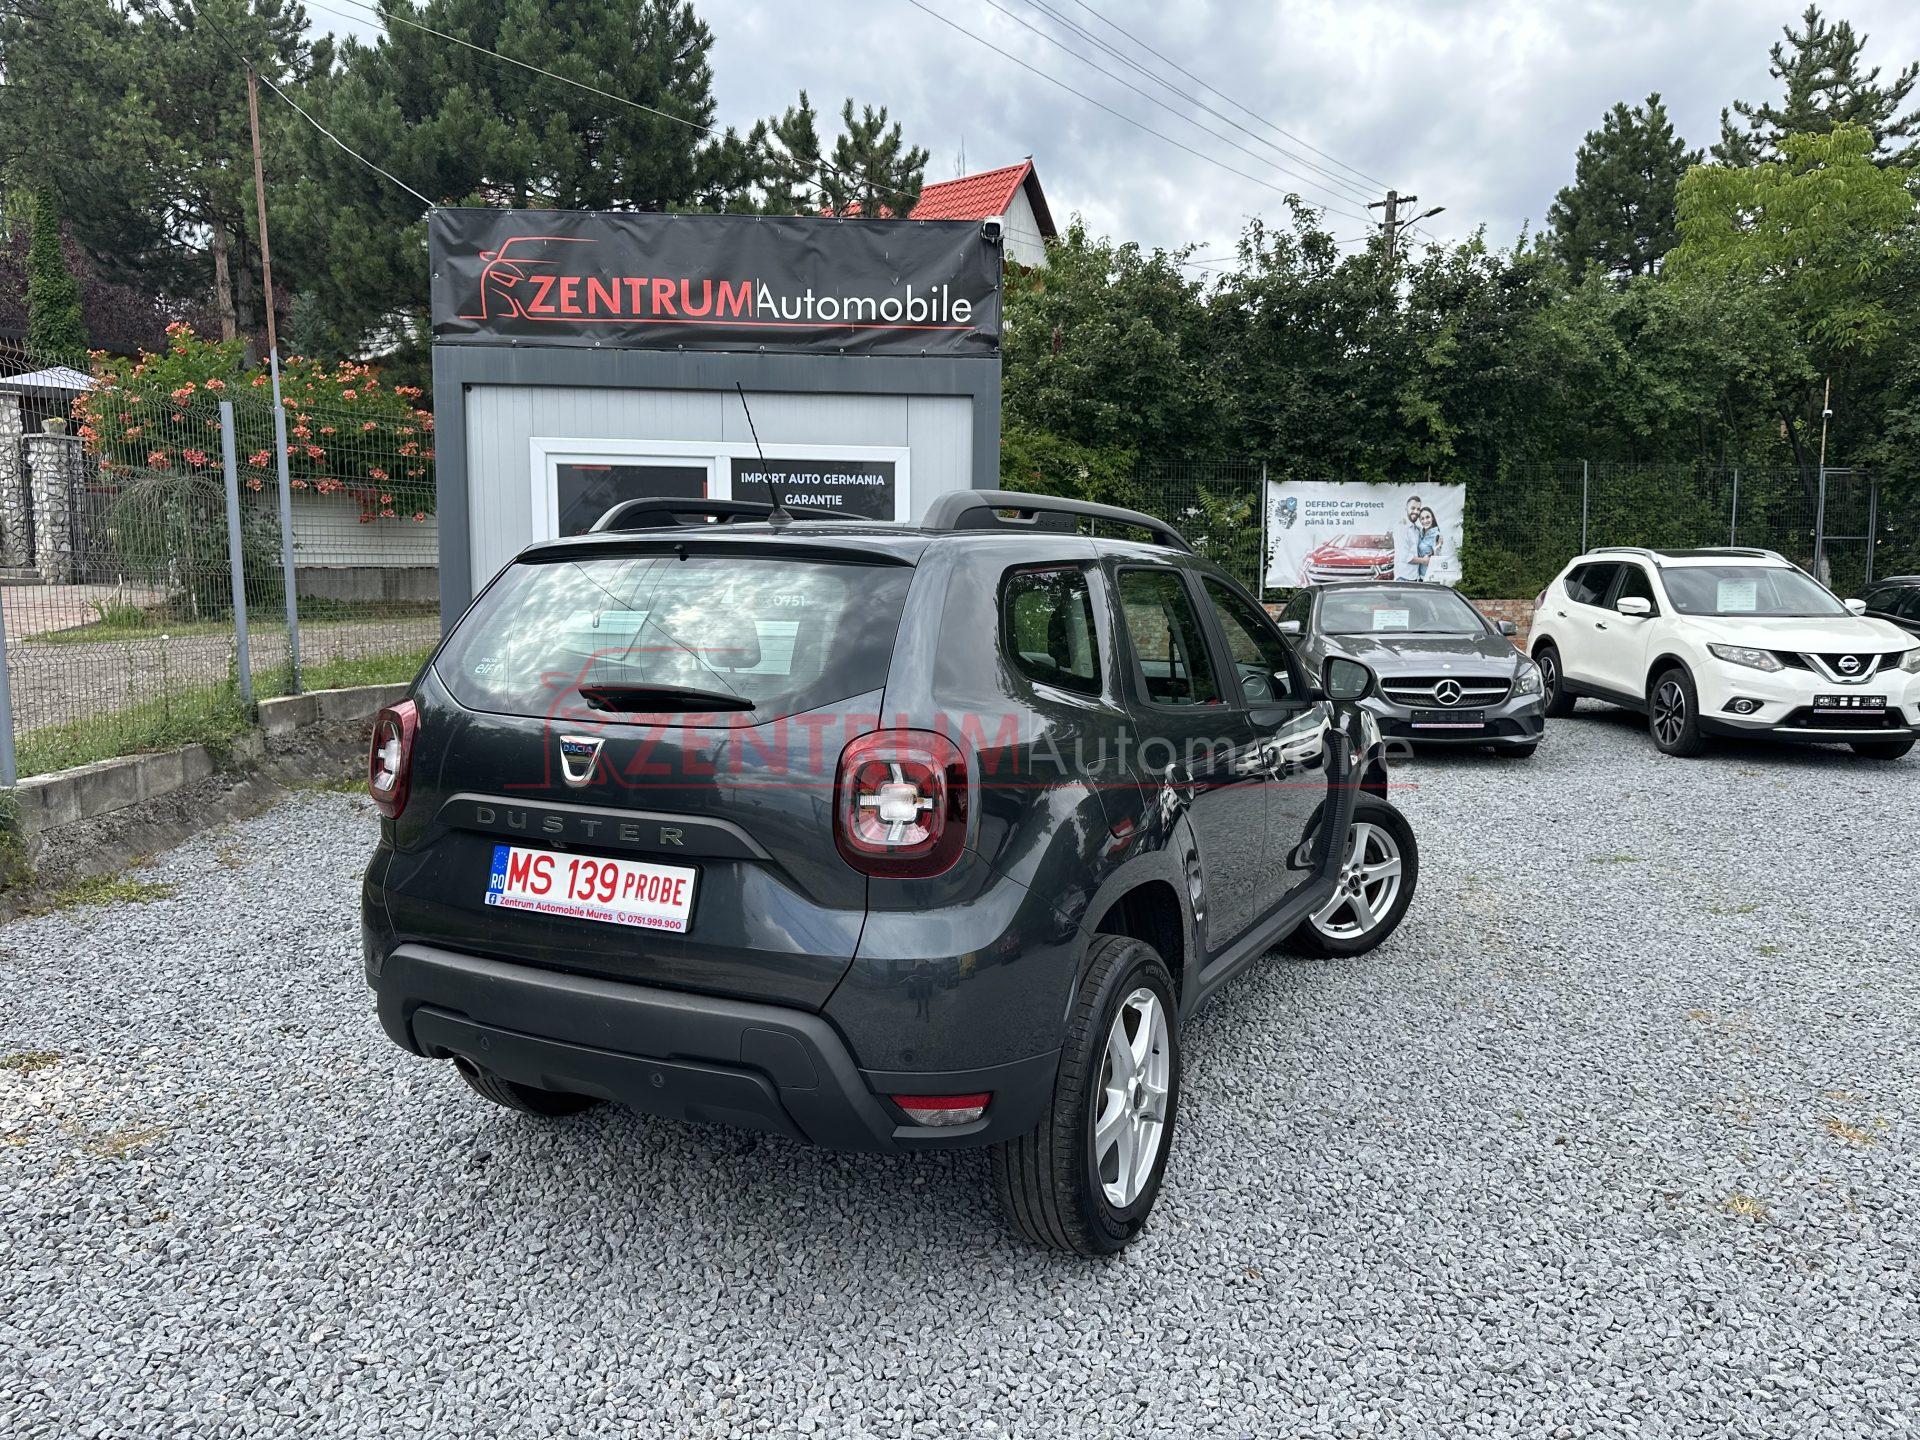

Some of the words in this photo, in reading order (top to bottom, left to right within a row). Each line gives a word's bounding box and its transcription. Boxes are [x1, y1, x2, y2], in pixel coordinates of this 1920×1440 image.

[528, 276, 752, 317] ZENTRUM
[758, 283, 972, 323] Automobile
[741, 472, 786, 484] IMPORT
[789, 473, 820, 485] AUTO
[823, 474, 885, 485] GERMANIA
[563, 744, 593, 753] DACIA
[476, 806, 685, 846] DUSTER
[490, 873, 504, 890] RO
[507, 852, 556, 895] MS
[567, 860, 619, 903] 139
[622, 872, 687, 906] PROBE
[500, 896, 534, 911] Zentrum
[535, 901, 585, 918] Automobile
[586, 908, 613, 921] Mures
[627, 915, 682, 930] 0751.999.900
